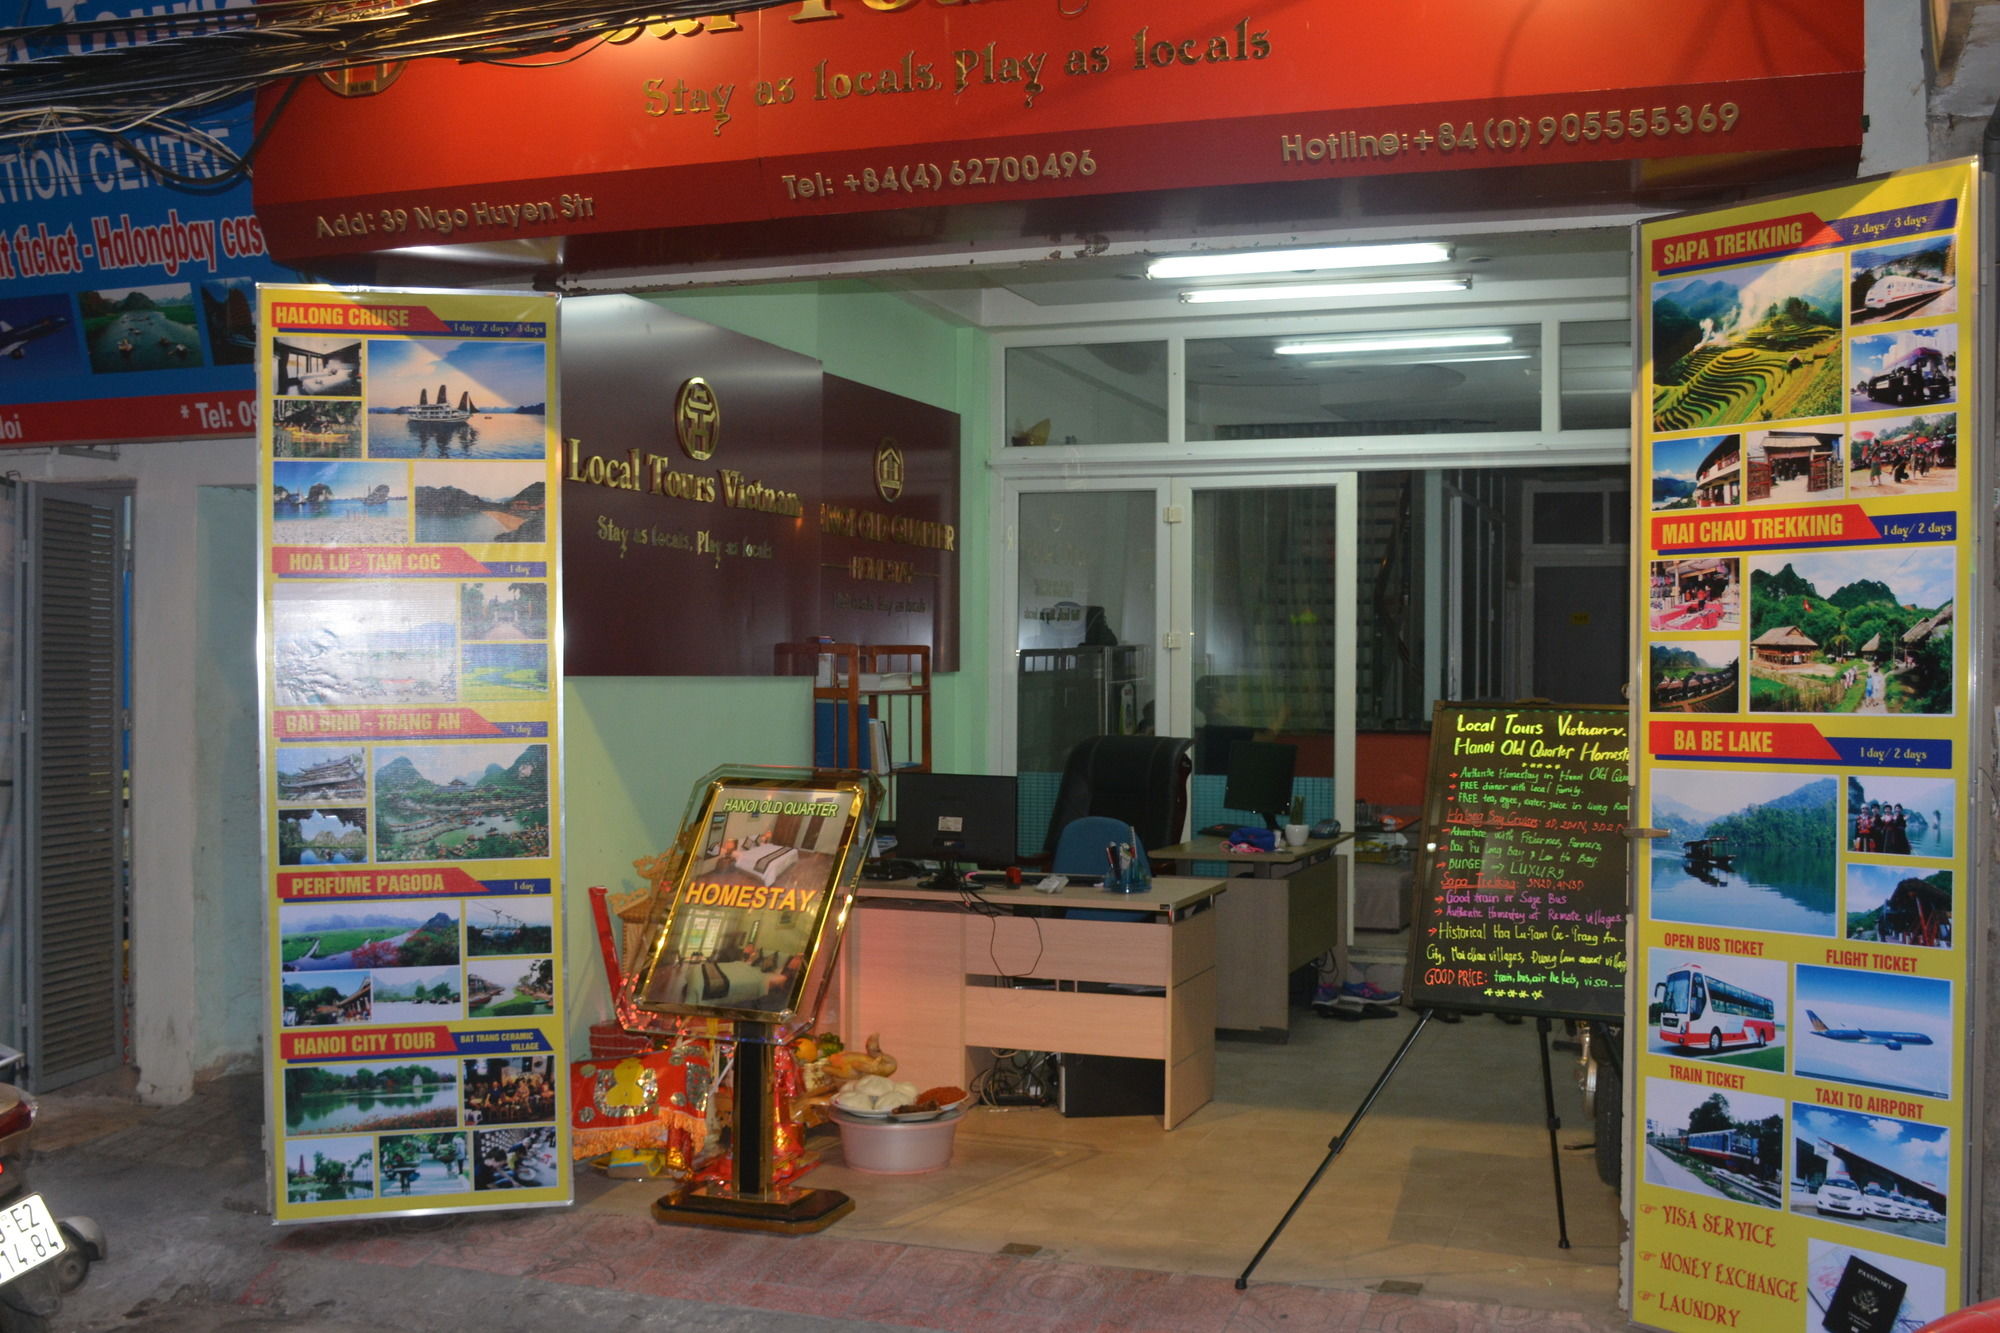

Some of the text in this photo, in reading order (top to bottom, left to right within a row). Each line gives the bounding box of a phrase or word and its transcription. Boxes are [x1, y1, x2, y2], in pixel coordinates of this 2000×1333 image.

[642, 77, 735, 136] Stay
[754, 76, 796, 106] as
[953, 41, 1047, 109] Play
[1064, 45, 1110, 75] as
[1132, 16, 1273, 70] locals
[782, 172, 834, 200] Tel:
[315, 193, 595, 241] Add: 39 Ngo Huyen Str
[1853, 214, 1928, 235] 2 3 days
[13, 221, 83, 277] ticket
[91, 208, 216, 277] Halongbay
[1663, 221, 1803, 265] SAPA TREKKING
[276, 306, 409, 327] HALONG CRUISE
[196, 402, 234, 429] Tel:
[567, 437, 803, 517] Local Tours Vietnam
[597, 515, 628, 559] Stay
[1662, 514, 1844, 545] MAI CHAU TREKKING
[1917, 523, 1926, 535] 2
[1928, 521, 1953, 540] days
[289, 552, 441, 571] HOA LU TAM COC
[285, 715, 314, 734] BAI
[378, 713, 433, 732] TRANG
[437, 712, 461, 730] AN
[1456, 714, 1496, 732] Local
[1505, 713, 1544, 735] Tours
[1454, 737, 1575, 760] Hanoi Old Quarter
[1674, 729, 1773, 753] BA BE LAKE
[1893, 748, 1901, 760] 2
[1903, 749, 1928, 767] days
[1589, 766, 1609, 781] Old
[1458, 791, 1479, 804] FREE
[1460, 781, 1480, 791] FREE
[723, 799, 839, 817] HANOI OLD QUARTER
[291, 874, 445, 896] PERFUME PAGODA
[520, 881, 536, 895] day
[684, 881, 816, 912] HOMESTAY
[1446, 889, 1472, 904] Good
[1474, 893, 1501, 904] train
[1548, 892, 1568, 905] Bus
[1438, 921, 1487, 940] Historical
[1664, 932, 1765, 957] OPEN BUS TICKET
[1826, 949, 1918, 973] FLIGHT TICKET
[1424, 967, 1456, 986] GOOD
[293, 1032, 436, 1056] HANOI CITY TOUR
[460, 1031, 534, 1044] BAT TRANG CERAMIC
[510, 1042, 539, 1051] VILLAGE
[1669, 1064, 1746, 1091] TRAIN TICKET
[1815, 1087, 1925, 1120] TAXI TO AIRPORT
[1662, 1205, 1777, 1249] VISA SERVICE
[1659, 1251, 1801, 1304] MONEY EXCHANGE
[1659, 1290, 1741, 1329] LAUNDRY
